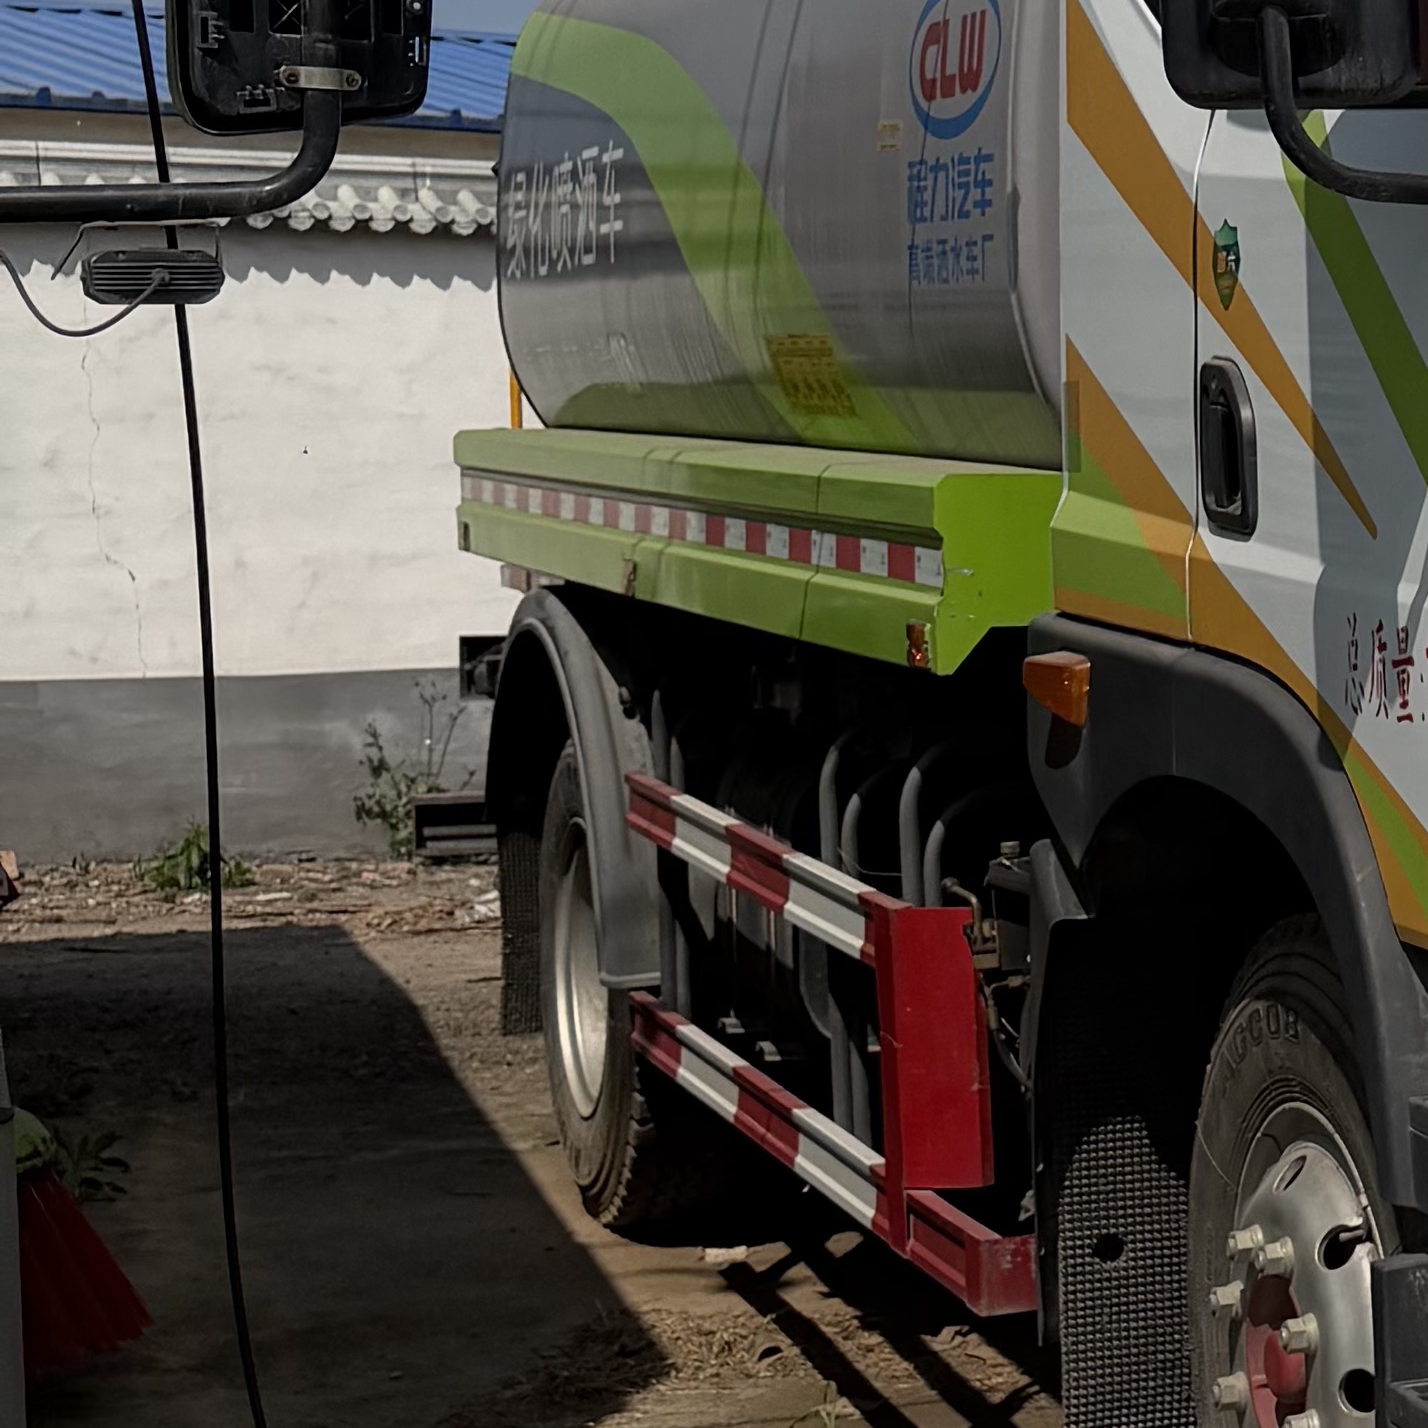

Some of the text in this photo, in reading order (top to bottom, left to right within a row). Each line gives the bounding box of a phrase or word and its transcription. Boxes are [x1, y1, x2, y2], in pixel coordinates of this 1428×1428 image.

[919, 9, 987, 103] CLW
[507, 139, 625, 280] 绿化喷洒车
[907, 147, 995, 224] 程力汽车
